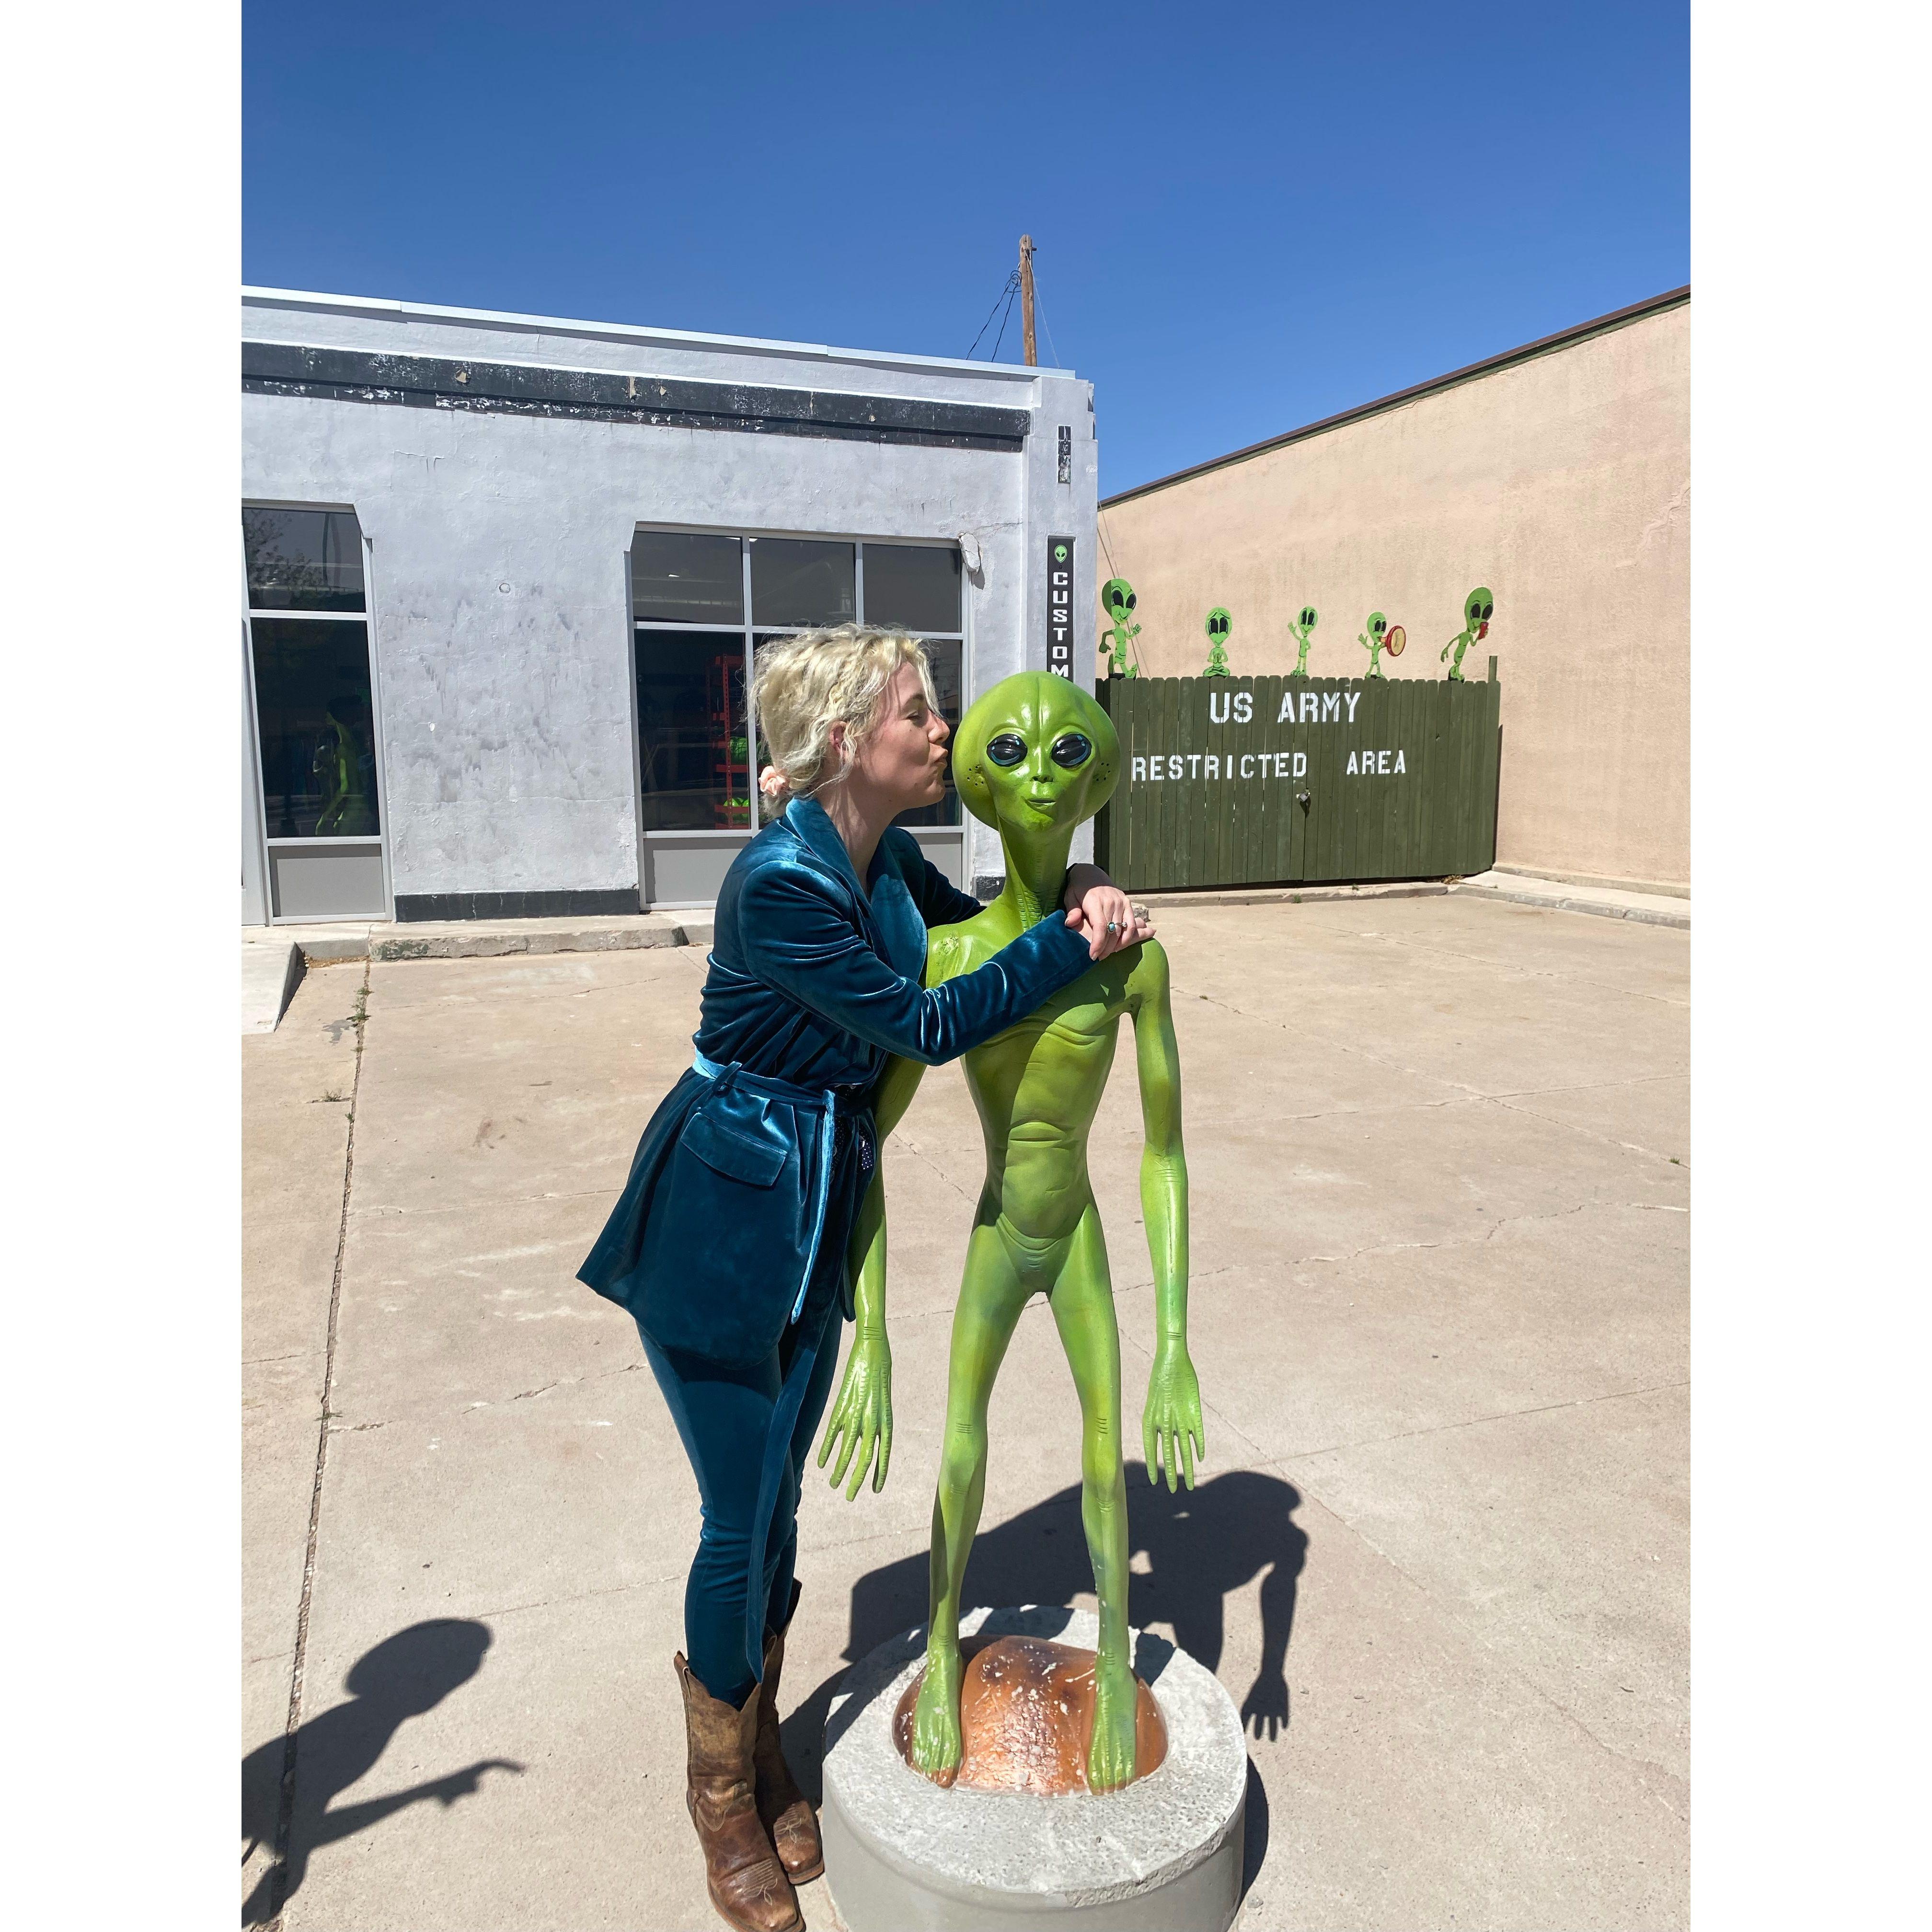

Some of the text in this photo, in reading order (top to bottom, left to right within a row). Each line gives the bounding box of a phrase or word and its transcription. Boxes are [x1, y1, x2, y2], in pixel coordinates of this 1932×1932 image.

[1051, 572, 1069, 678] CUSTOM
[1210, 692, 1361, 724] US ARMY
[1132, 750, 1406, 782] RESTRICTED AREA
